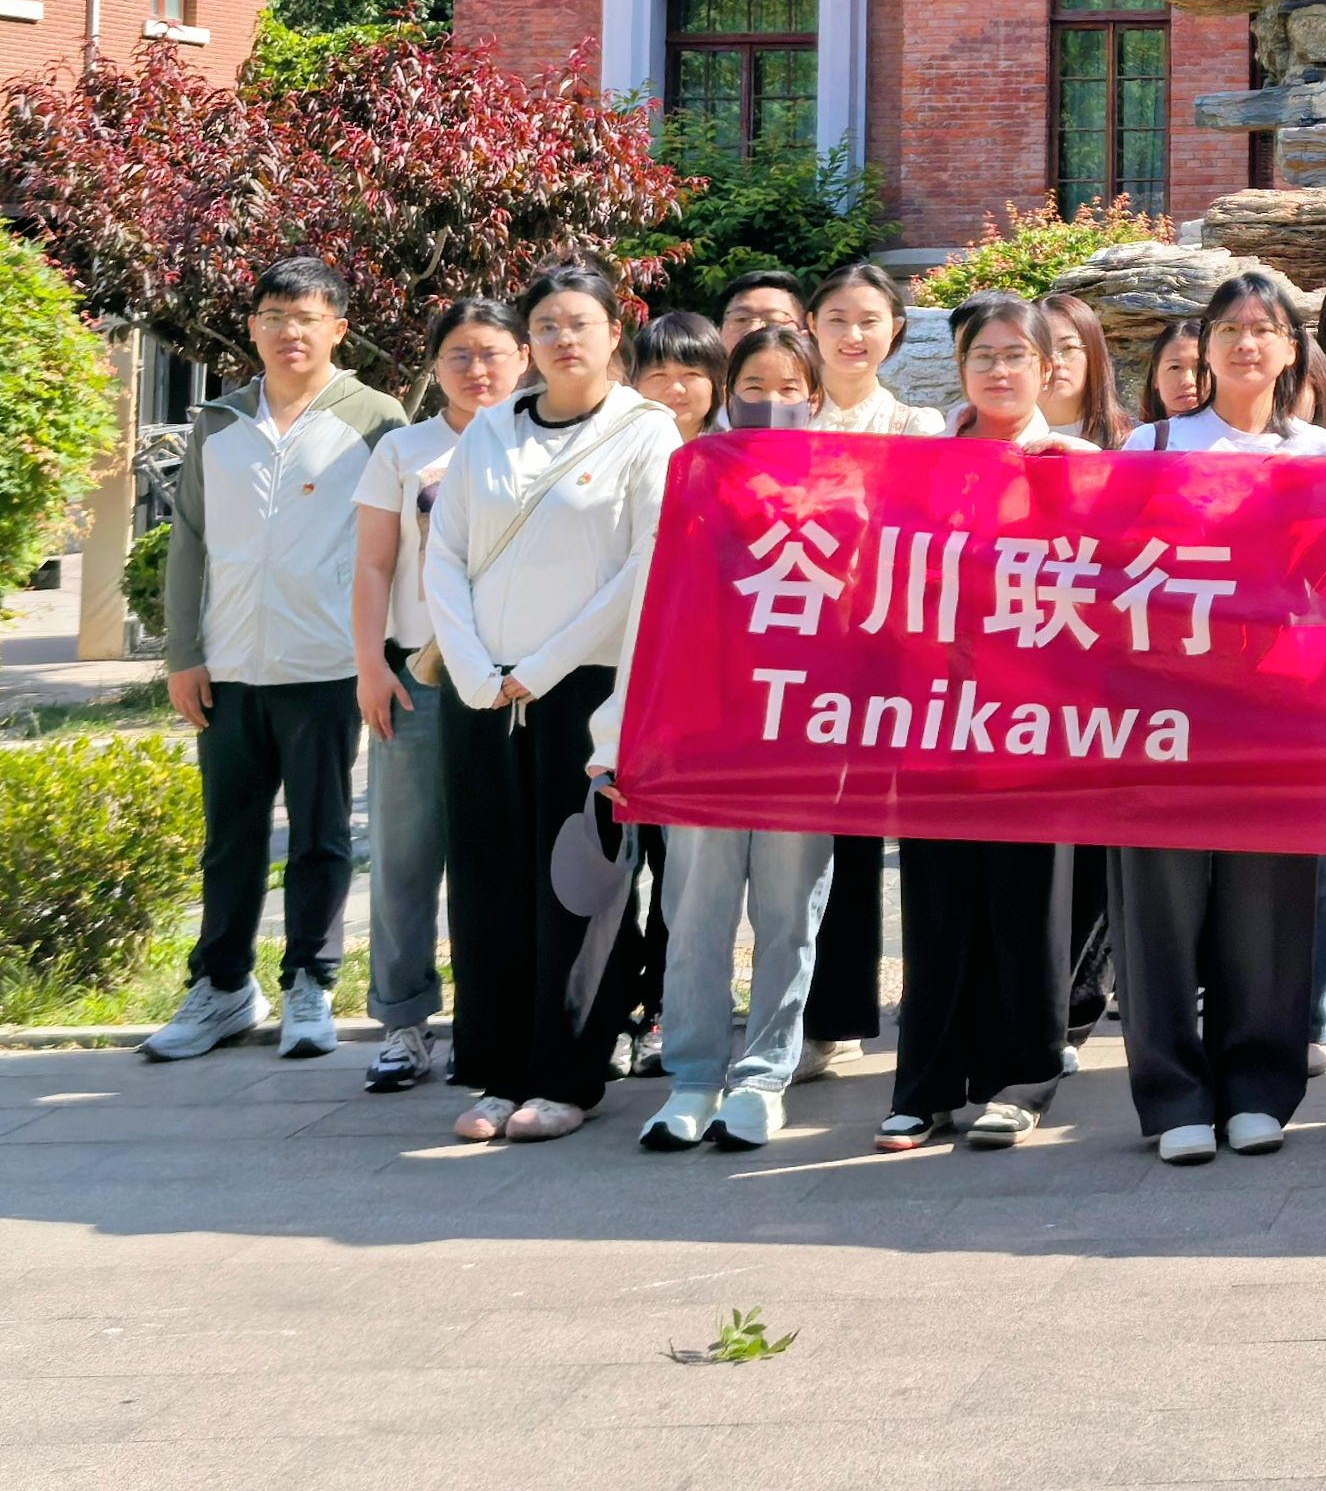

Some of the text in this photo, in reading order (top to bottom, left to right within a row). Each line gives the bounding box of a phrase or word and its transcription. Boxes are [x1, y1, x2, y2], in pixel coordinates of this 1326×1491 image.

[733, 519, 1237, 656] 谷川联行
[752, 668, 1191, 763] Tanikawa
